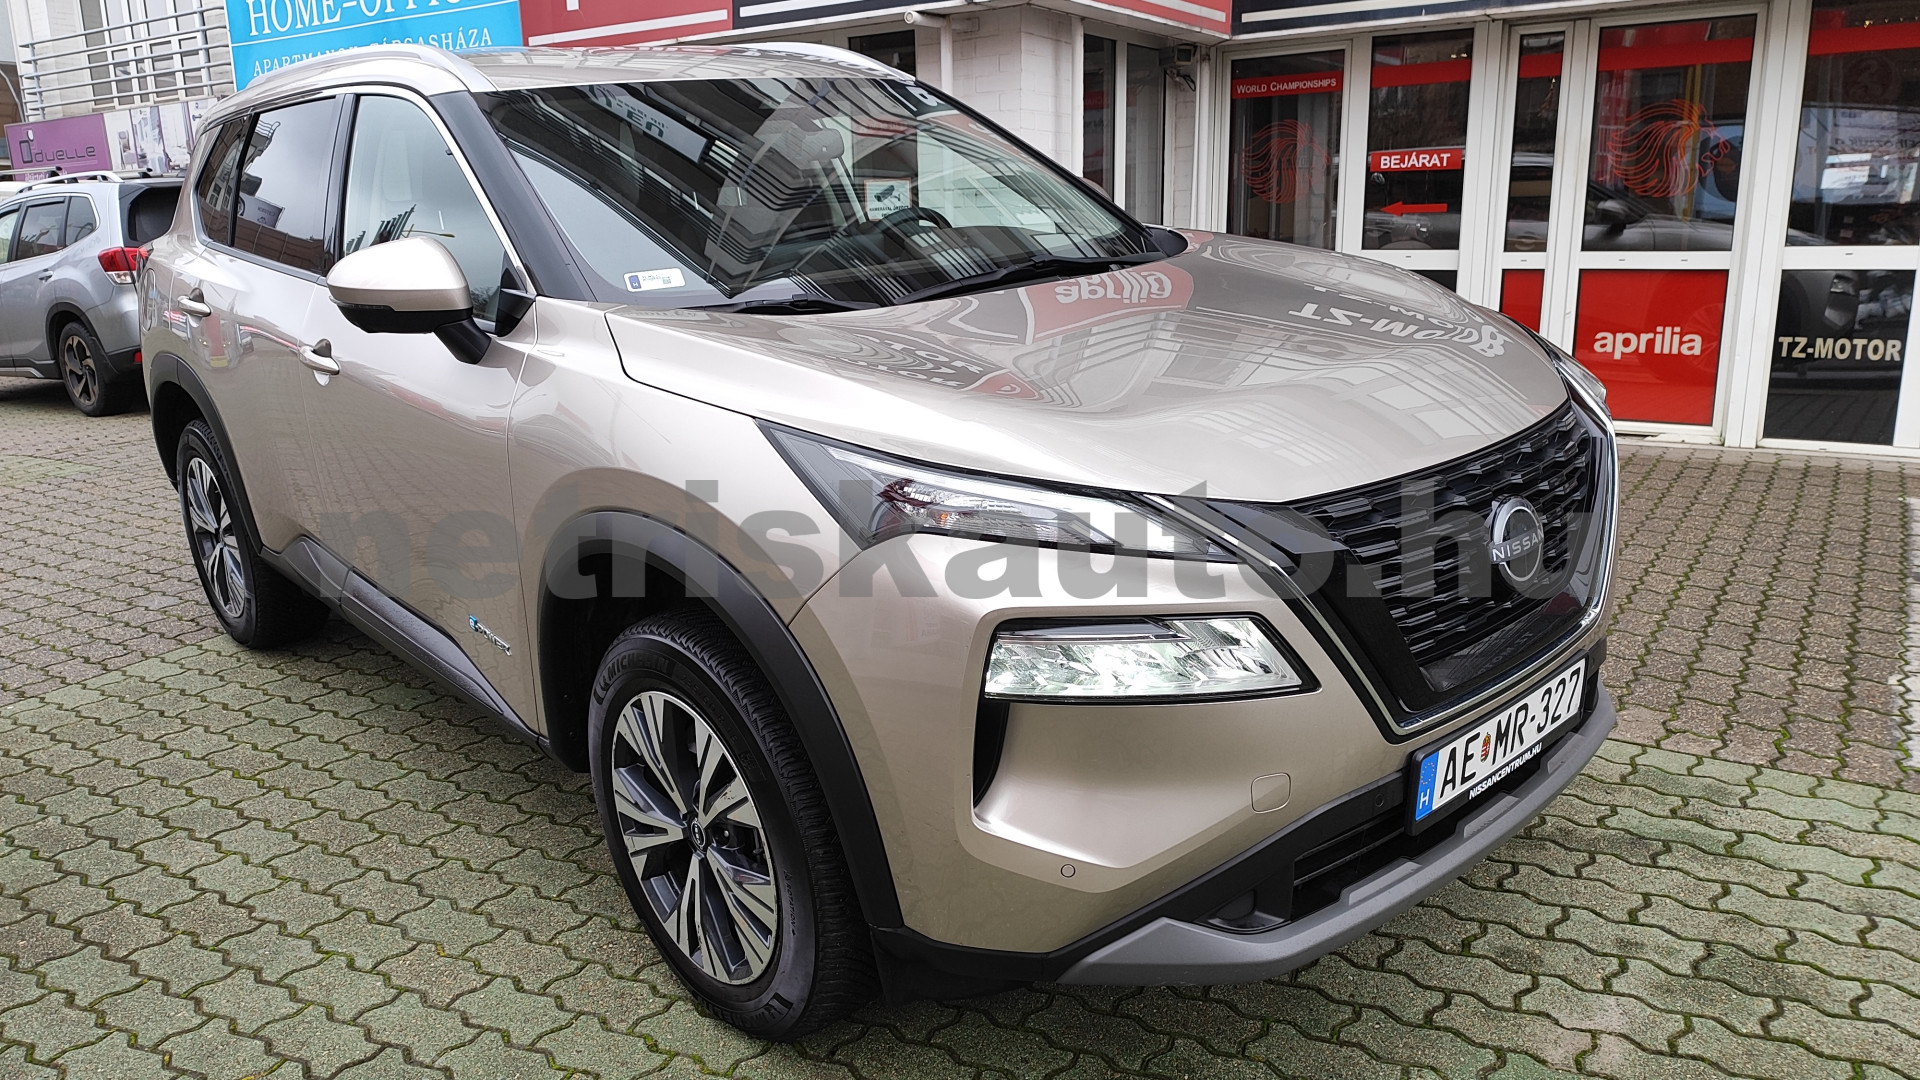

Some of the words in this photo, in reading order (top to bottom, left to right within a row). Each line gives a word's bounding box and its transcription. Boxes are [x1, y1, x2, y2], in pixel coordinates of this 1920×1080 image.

[246, 0, 461, 37] HOME-
[253, 45, 360, 77] APART
[369, 26, 493, 51] SHÁZA
[1380, 151, 1451, 169] BEJÁRAT
[1593, 326, 1703, 360] aprilia
[1778, 336, 1902, 361] TZ-MOTOR
[1492, 528, 1545, 562] NISSAN
[1440, 731, 1481, 798] AE
[1492, 666, 1581, 766] MR-327
[1468, 741, 1542, 800] NISSANCENTRUM.HU
[1418, 788, 1430, 811] H
